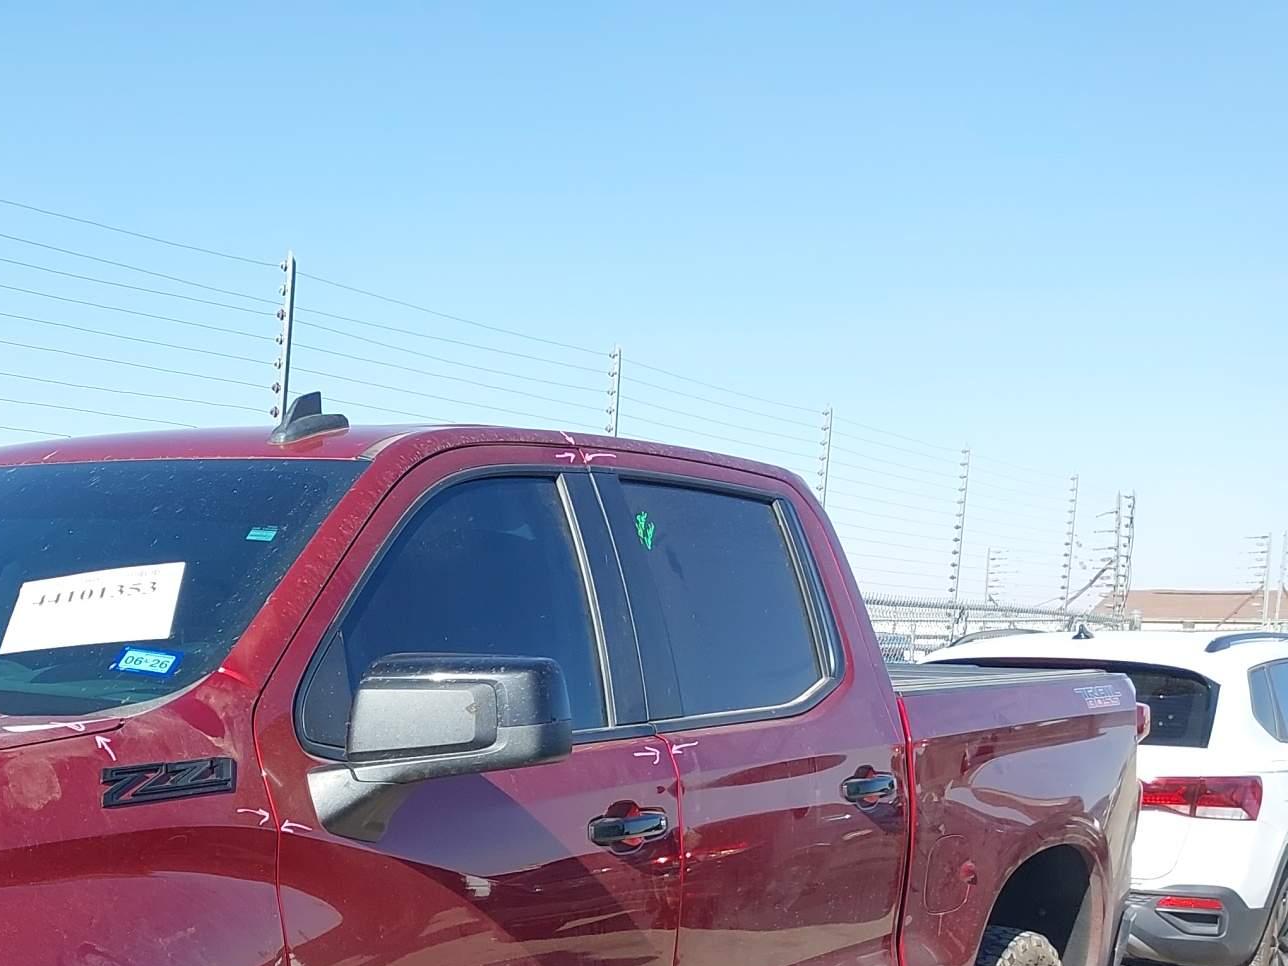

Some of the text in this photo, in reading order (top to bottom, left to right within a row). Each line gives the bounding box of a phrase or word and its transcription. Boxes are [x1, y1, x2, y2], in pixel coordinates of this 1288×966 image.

[124, 655, 145, 667] 06
[149, 657, 171, 671] 26
[1073, 685, 1121, 698] TRAIL
